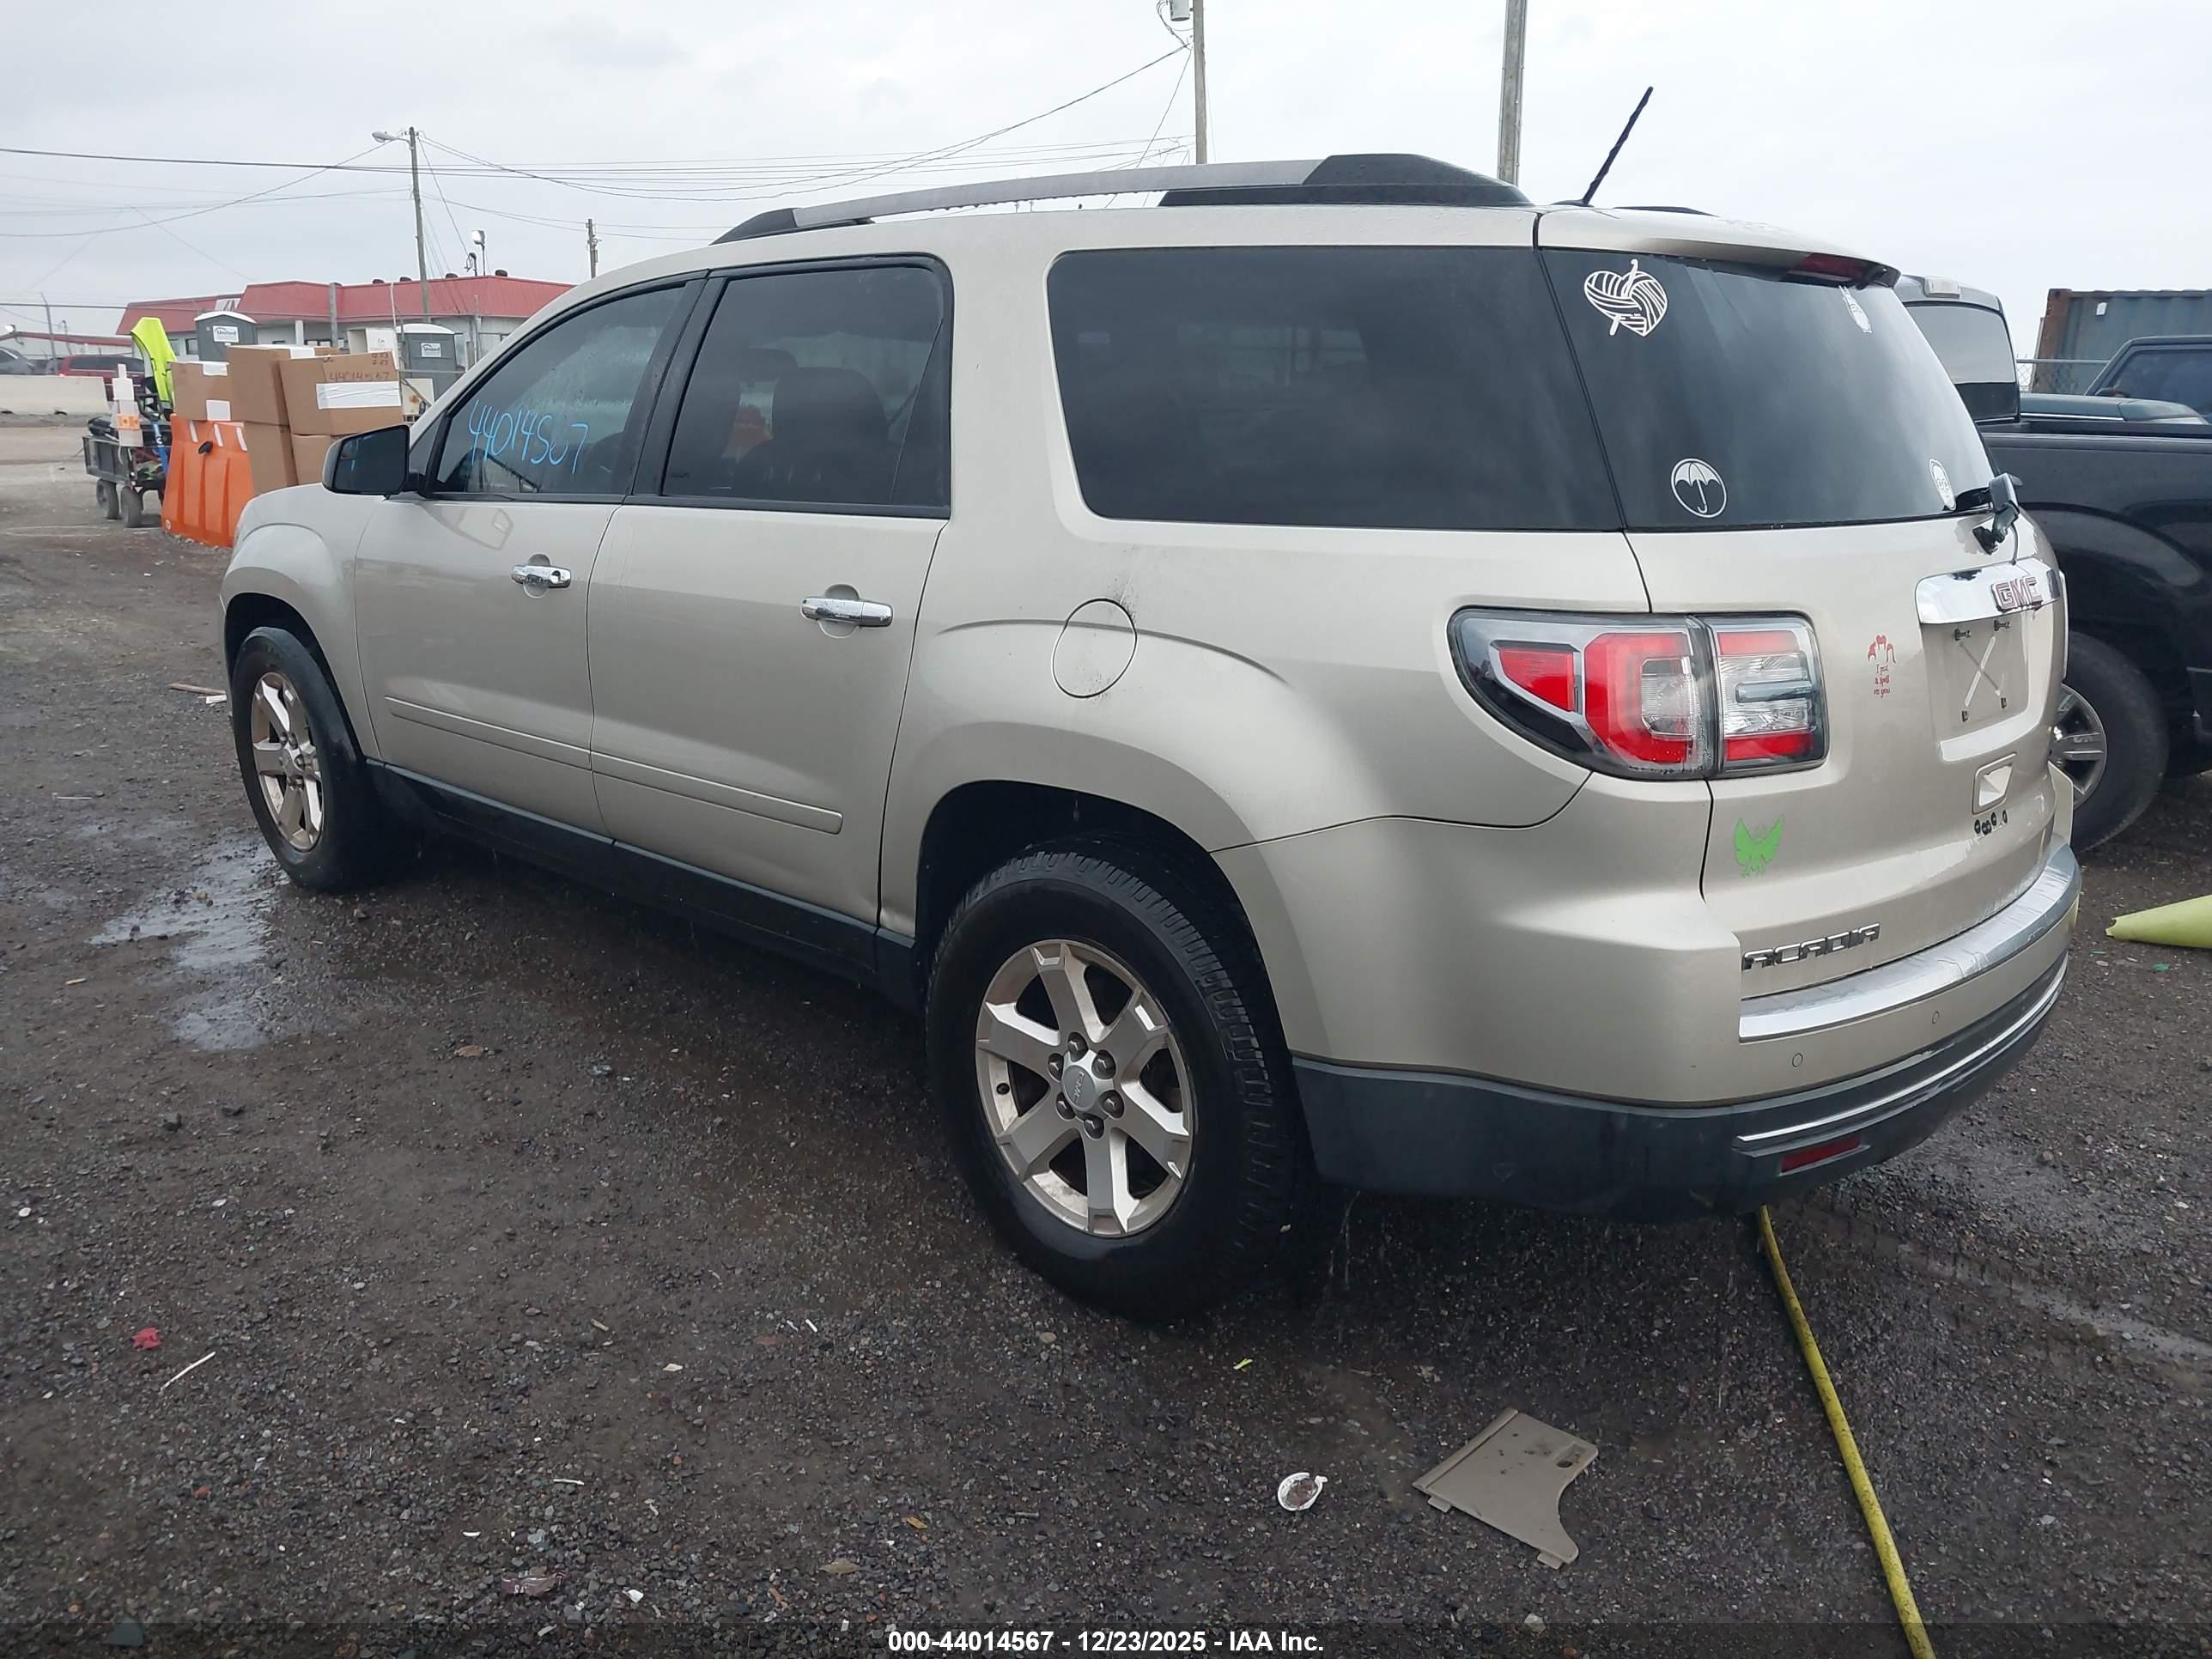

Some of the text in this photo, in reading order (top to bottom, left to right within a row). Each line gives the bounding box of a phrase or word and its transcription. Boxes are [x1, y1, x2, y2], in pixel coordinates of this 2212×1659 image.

[1991, 576, 2043, 611] GMC
[1741, 923, 1880, 971] ACADIA
[1073, 1071, 1085, 1105] GMC
